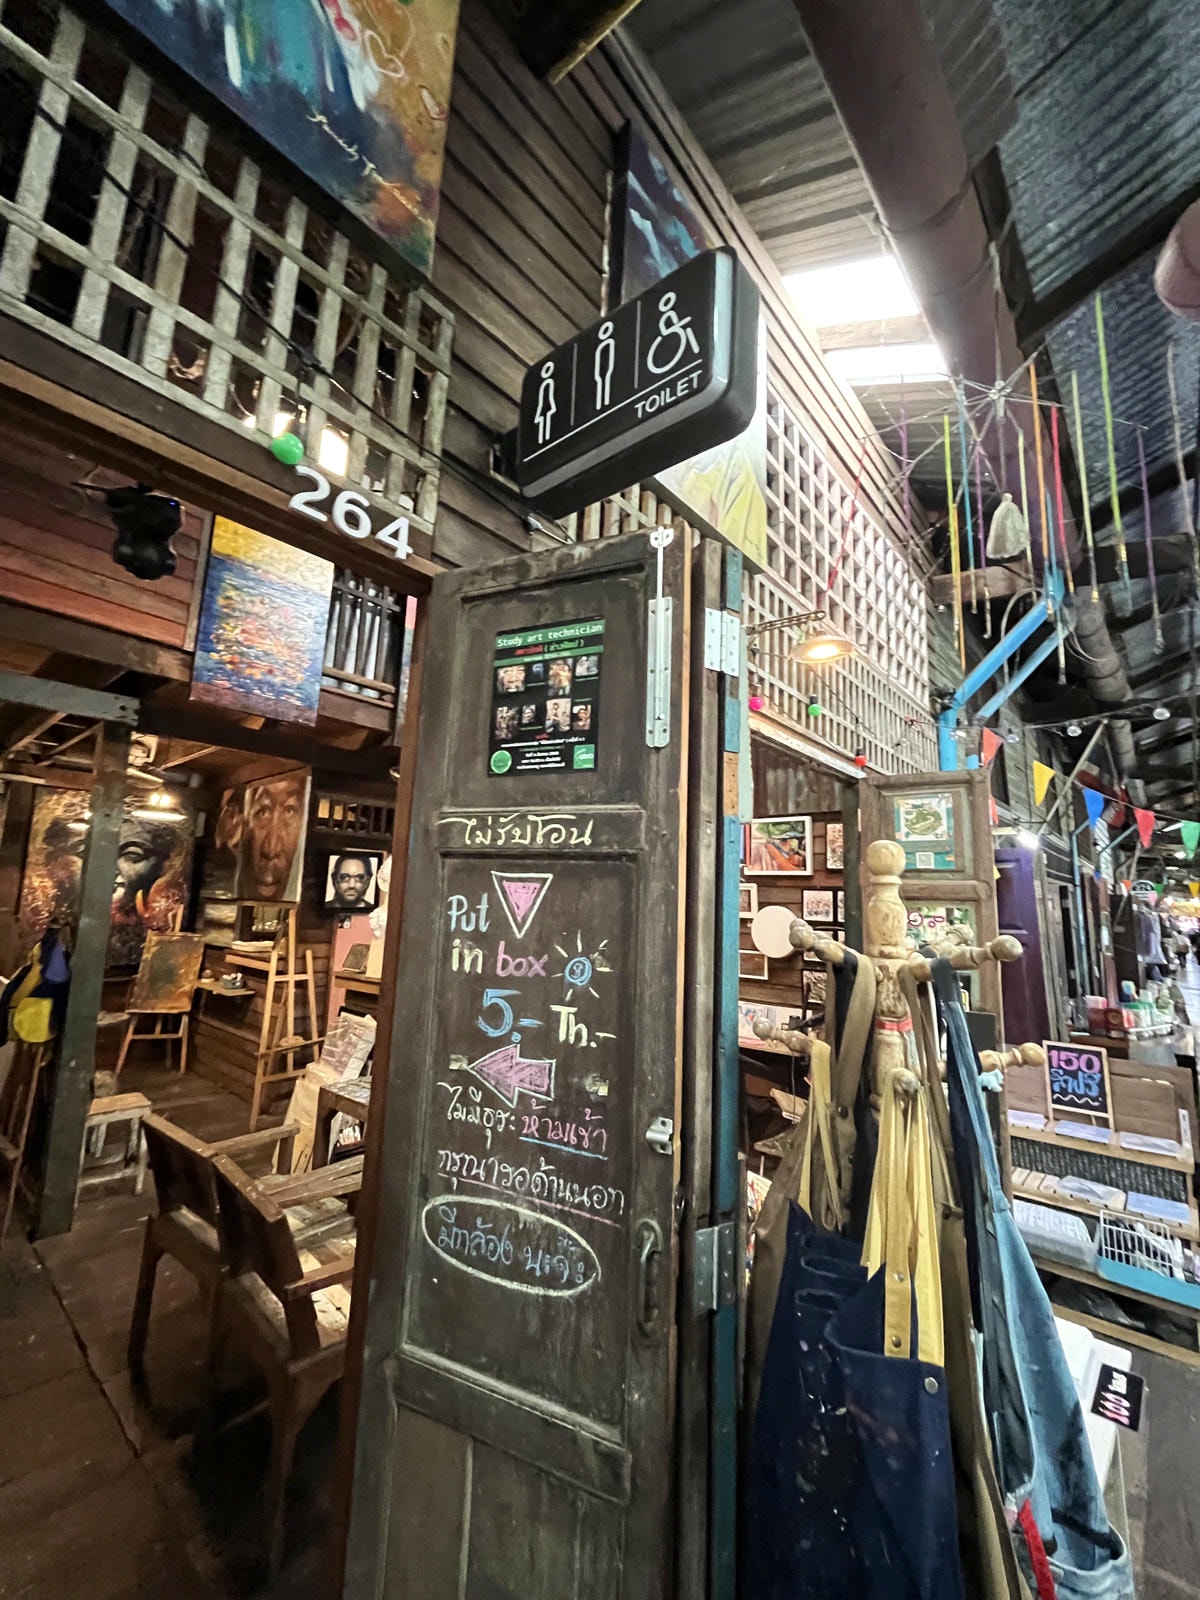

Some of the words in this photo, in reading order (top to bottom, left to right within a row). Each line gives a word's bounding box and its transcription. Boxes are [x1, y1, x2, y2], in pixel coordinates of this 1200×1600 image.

[634, 370, 703, 418] TOILET
[289, 465, 413, 560] 264
[497, 636, 523, 648] Study
[527, 632, 543, 642] art
[548, 624, 602, 639] technician
[436, 812, 594, 846] ไม่รับโอน
[447, 892, 491, 932] Put
[451, 938, 483, 975] in
[496, 940, 549, 978] box
[1048, 1049, 1101, 1074] 150
